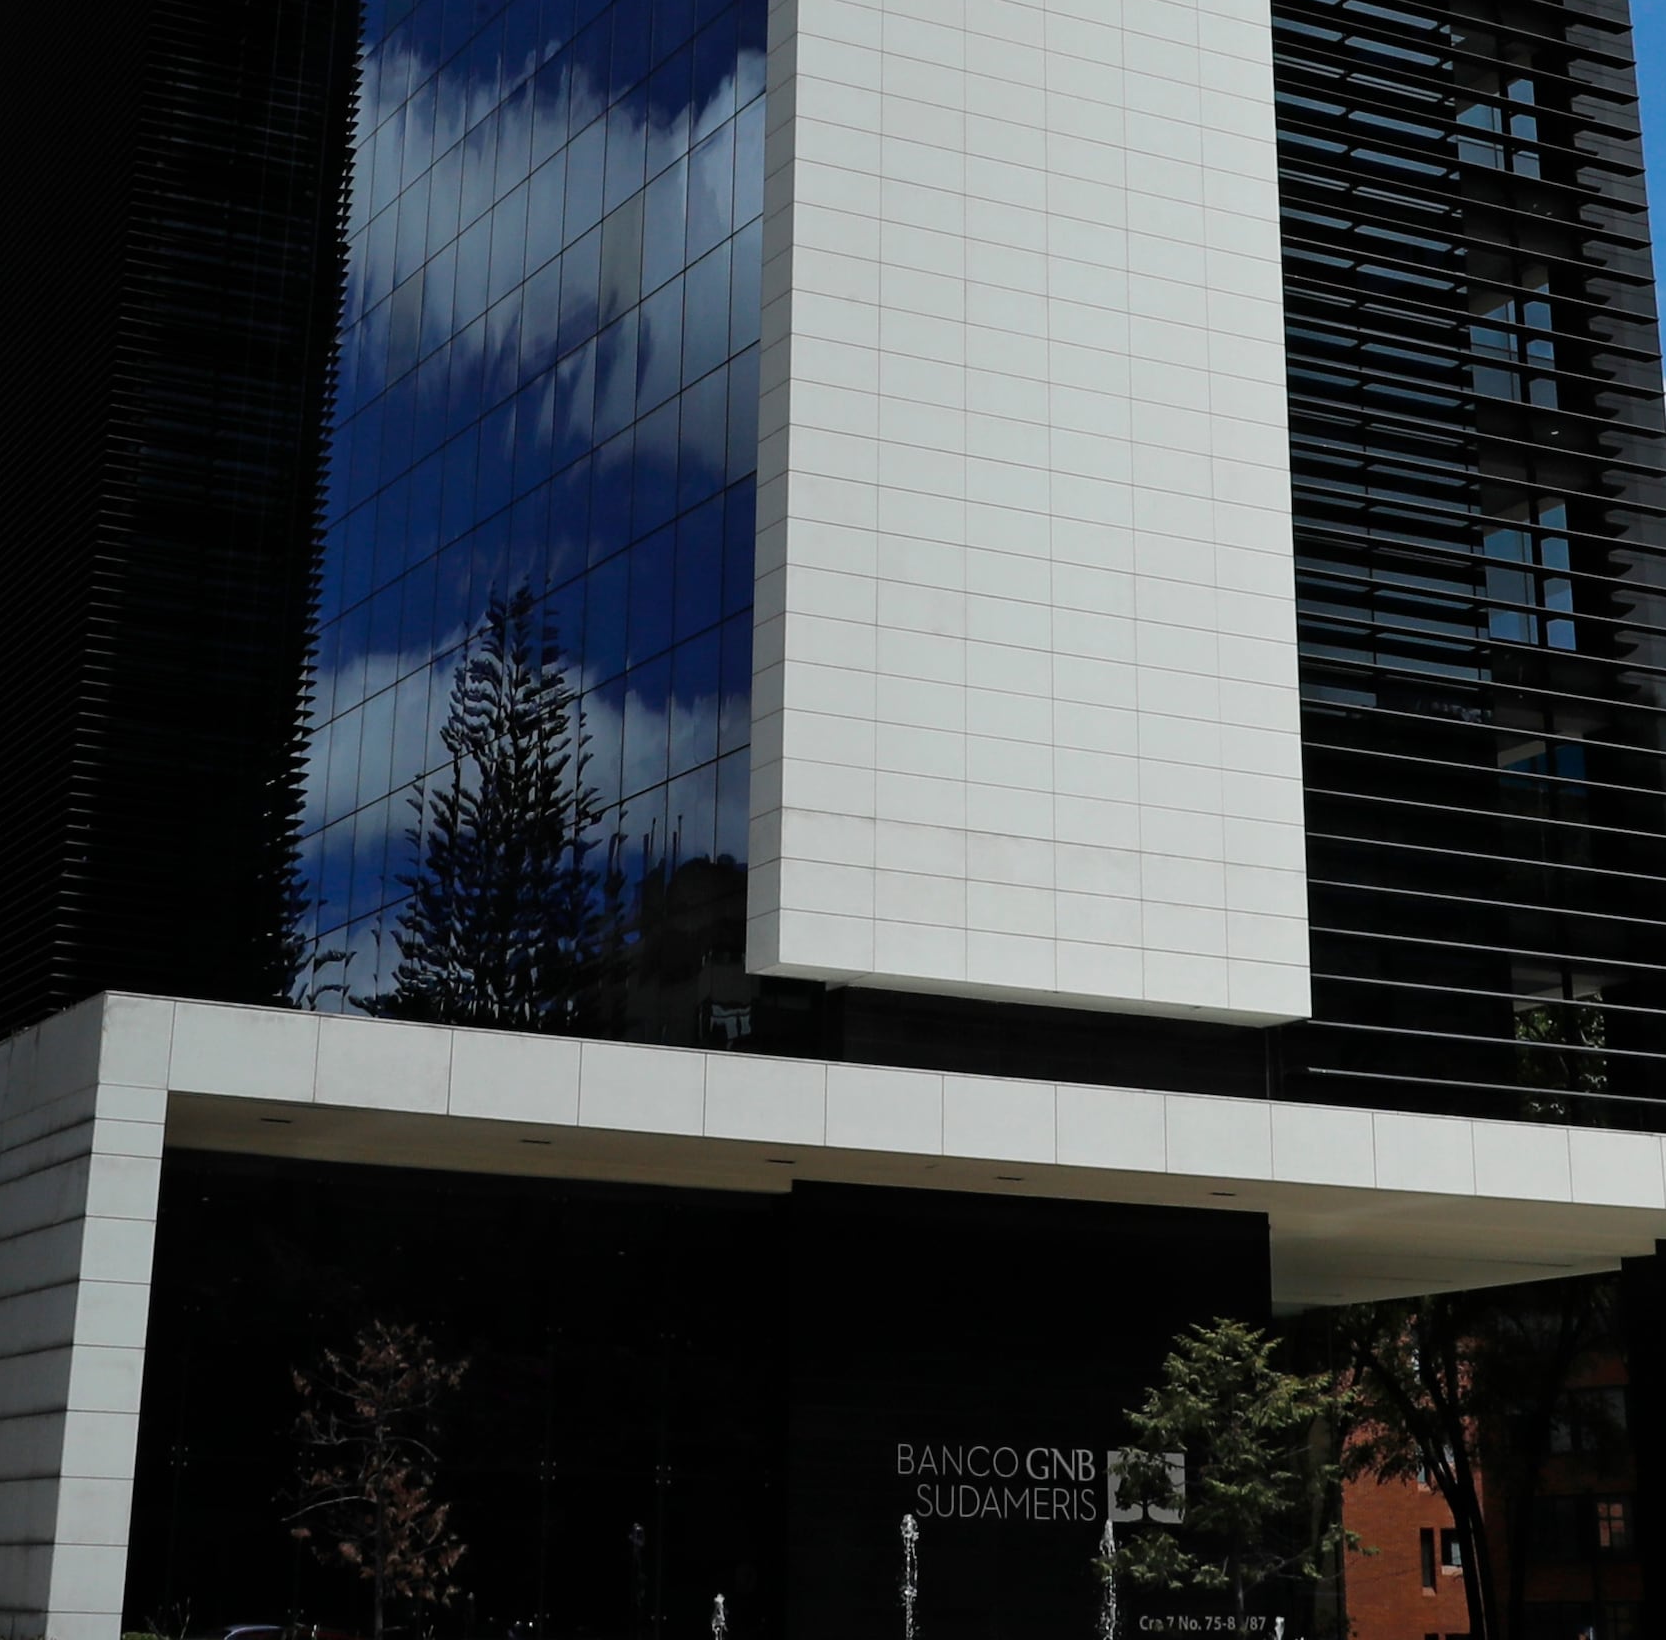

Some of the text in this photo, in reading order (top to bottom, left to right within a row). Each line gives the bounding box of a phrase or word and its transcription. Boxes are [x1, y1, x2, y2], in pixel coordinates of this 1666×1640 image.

[897, 1443, 1096, 1482] BANCO GNB
[915, 1483, 1097, 1522] SUDAMERIS
[1178, 1616, 1202, 1631] No.
[1204, 1616, 1266, 1631] 75-8/87
